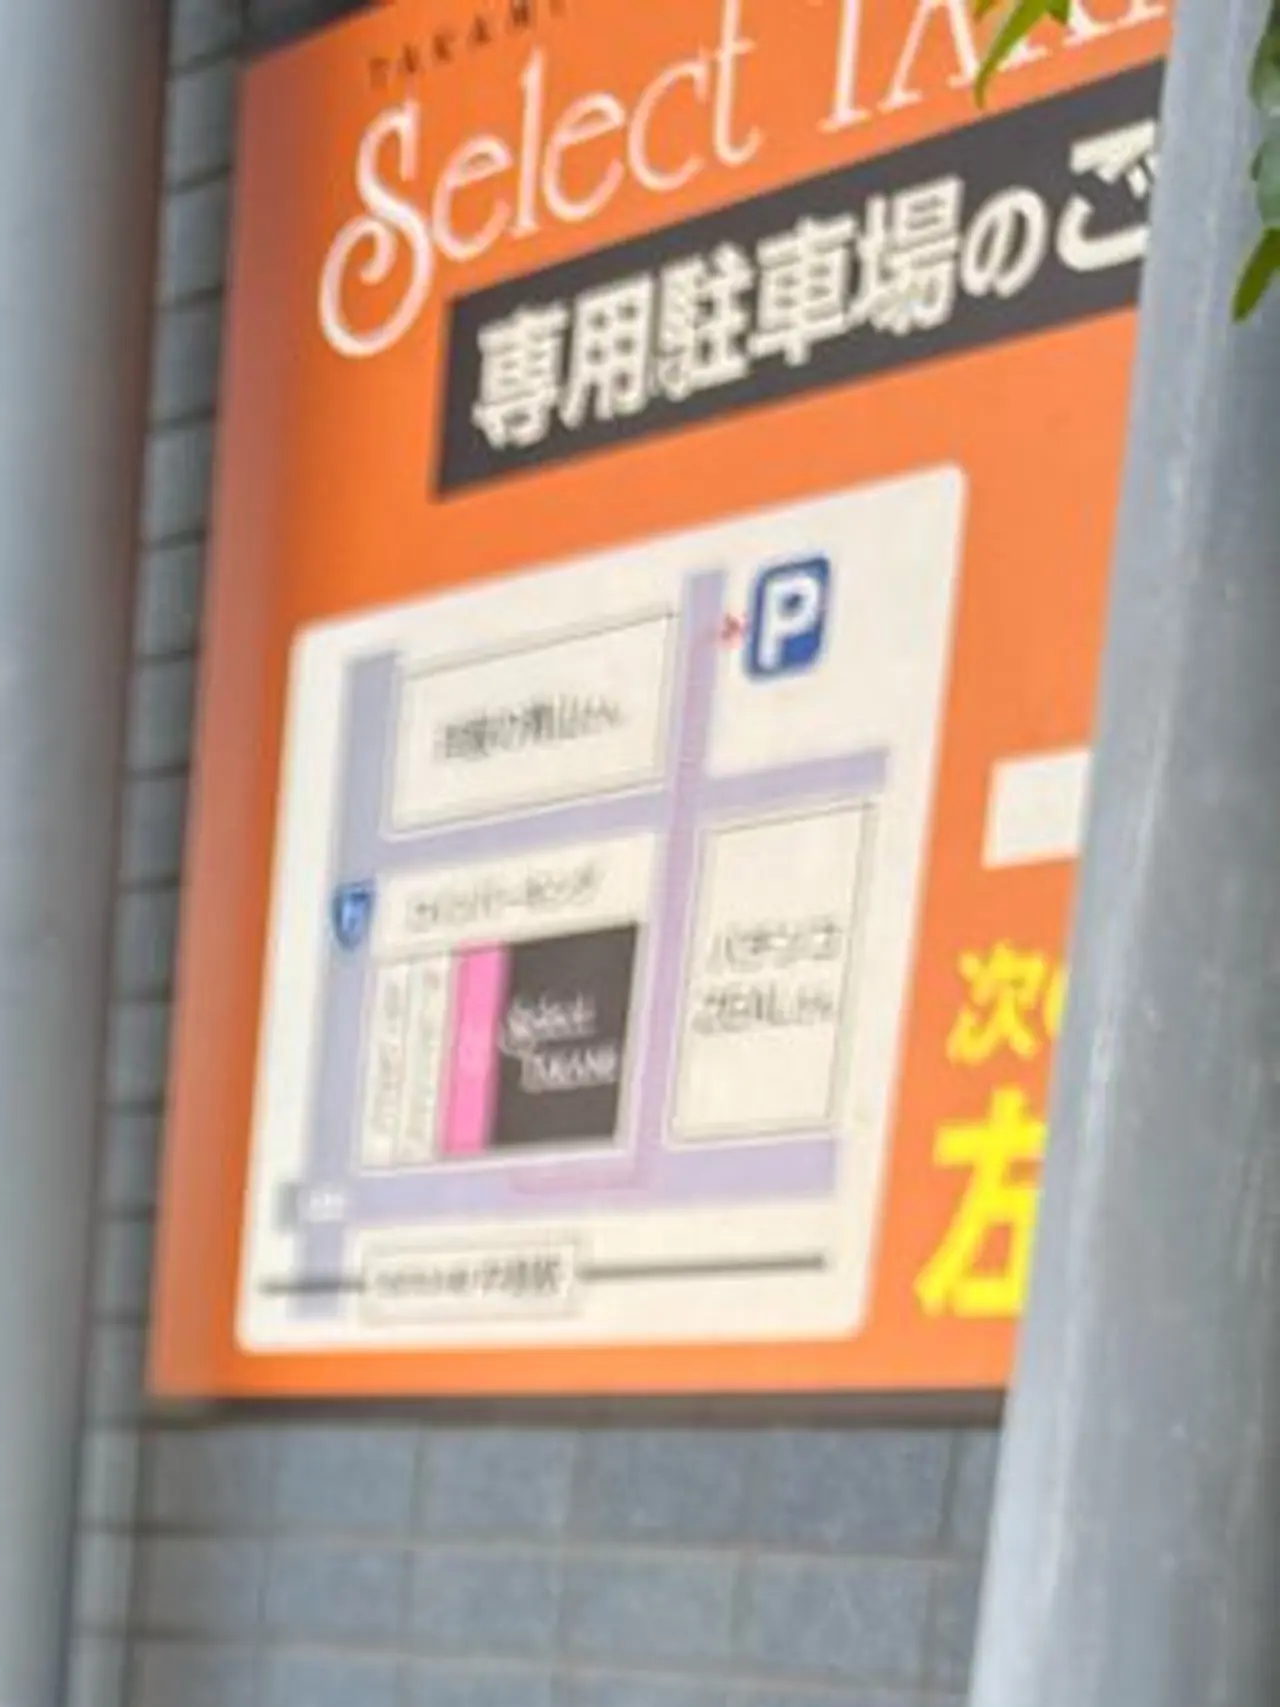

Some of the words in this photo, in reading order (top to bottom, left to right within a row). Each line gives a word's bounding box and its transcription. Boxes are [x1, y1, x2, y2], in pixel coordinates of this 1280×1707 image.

[321, 0, 765, 358] Select
[472, 118, 1160, 450] 専用駐車場のご
[758, 574, 821, 672] P
